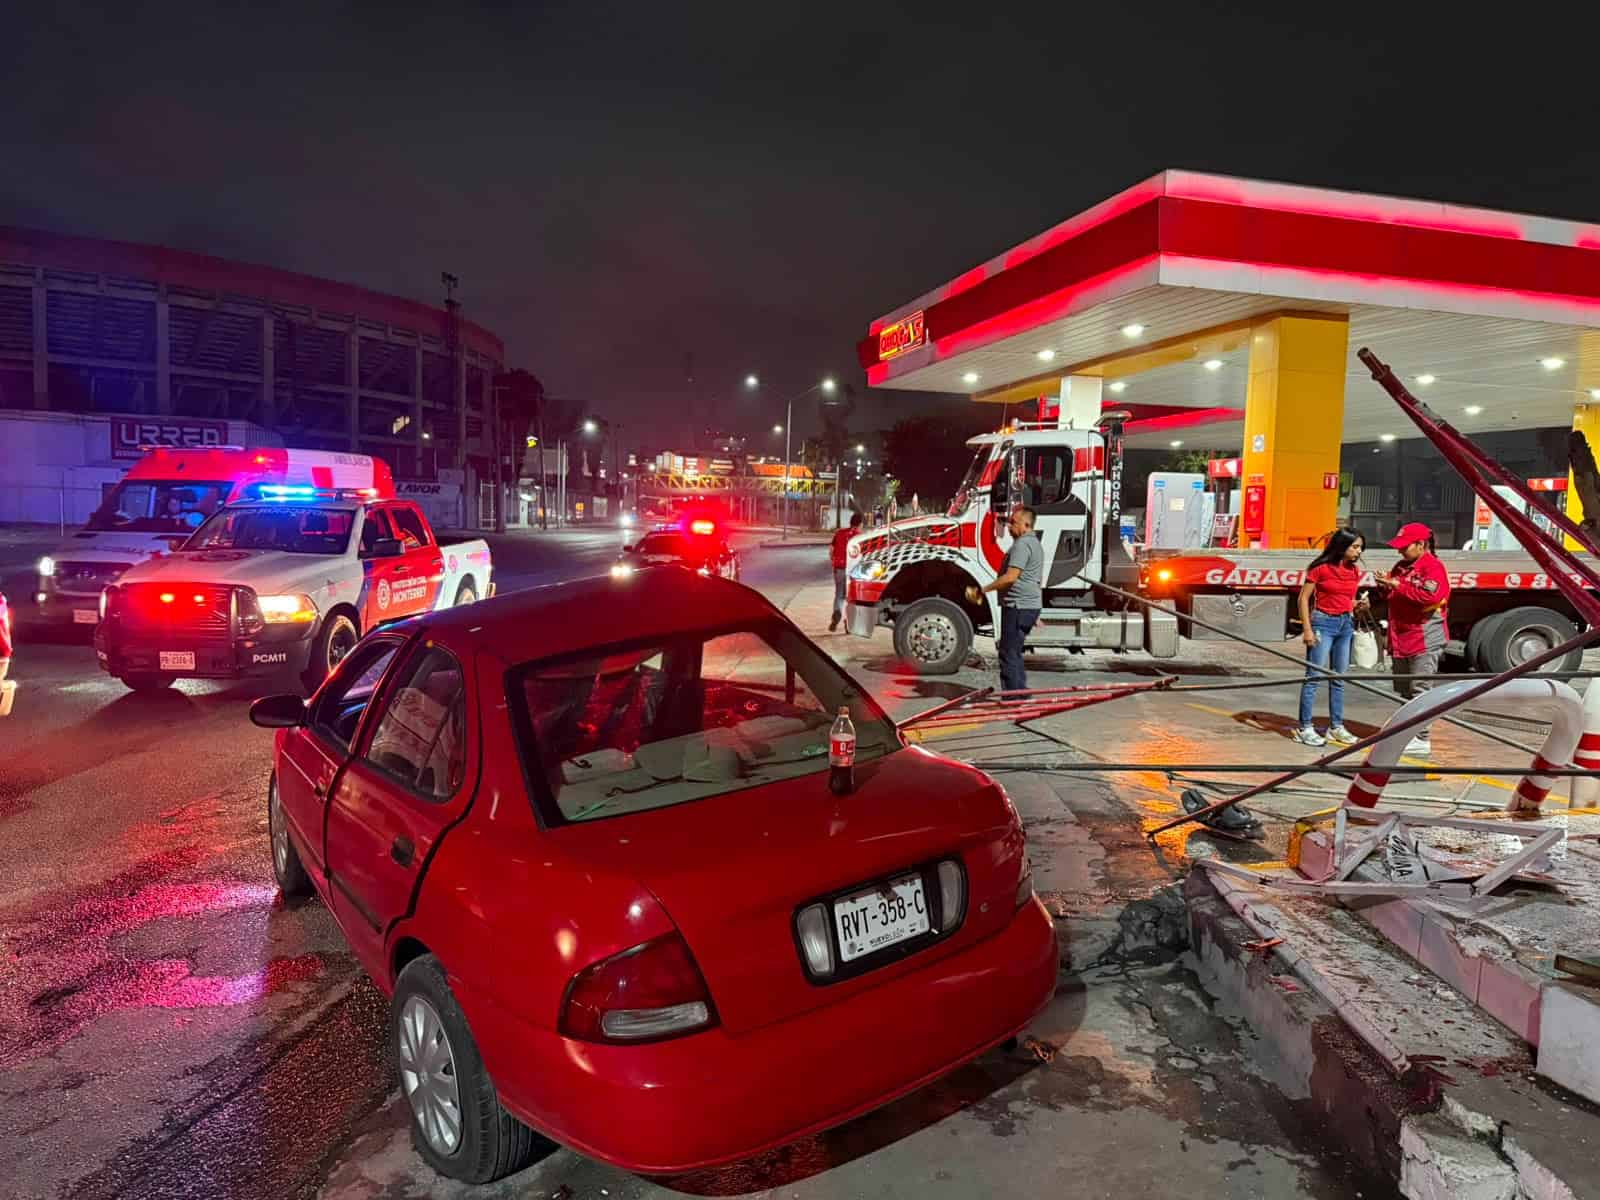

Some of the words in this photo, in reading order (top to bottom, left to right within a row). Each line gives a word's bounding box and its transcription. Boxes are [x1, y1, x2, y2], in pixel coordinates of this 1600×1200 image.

[1112, 472, 1121, 520] HORAS
[252, 653, 287, 664] PCM11
[840, 889, 924, 942] RVT-358-C
